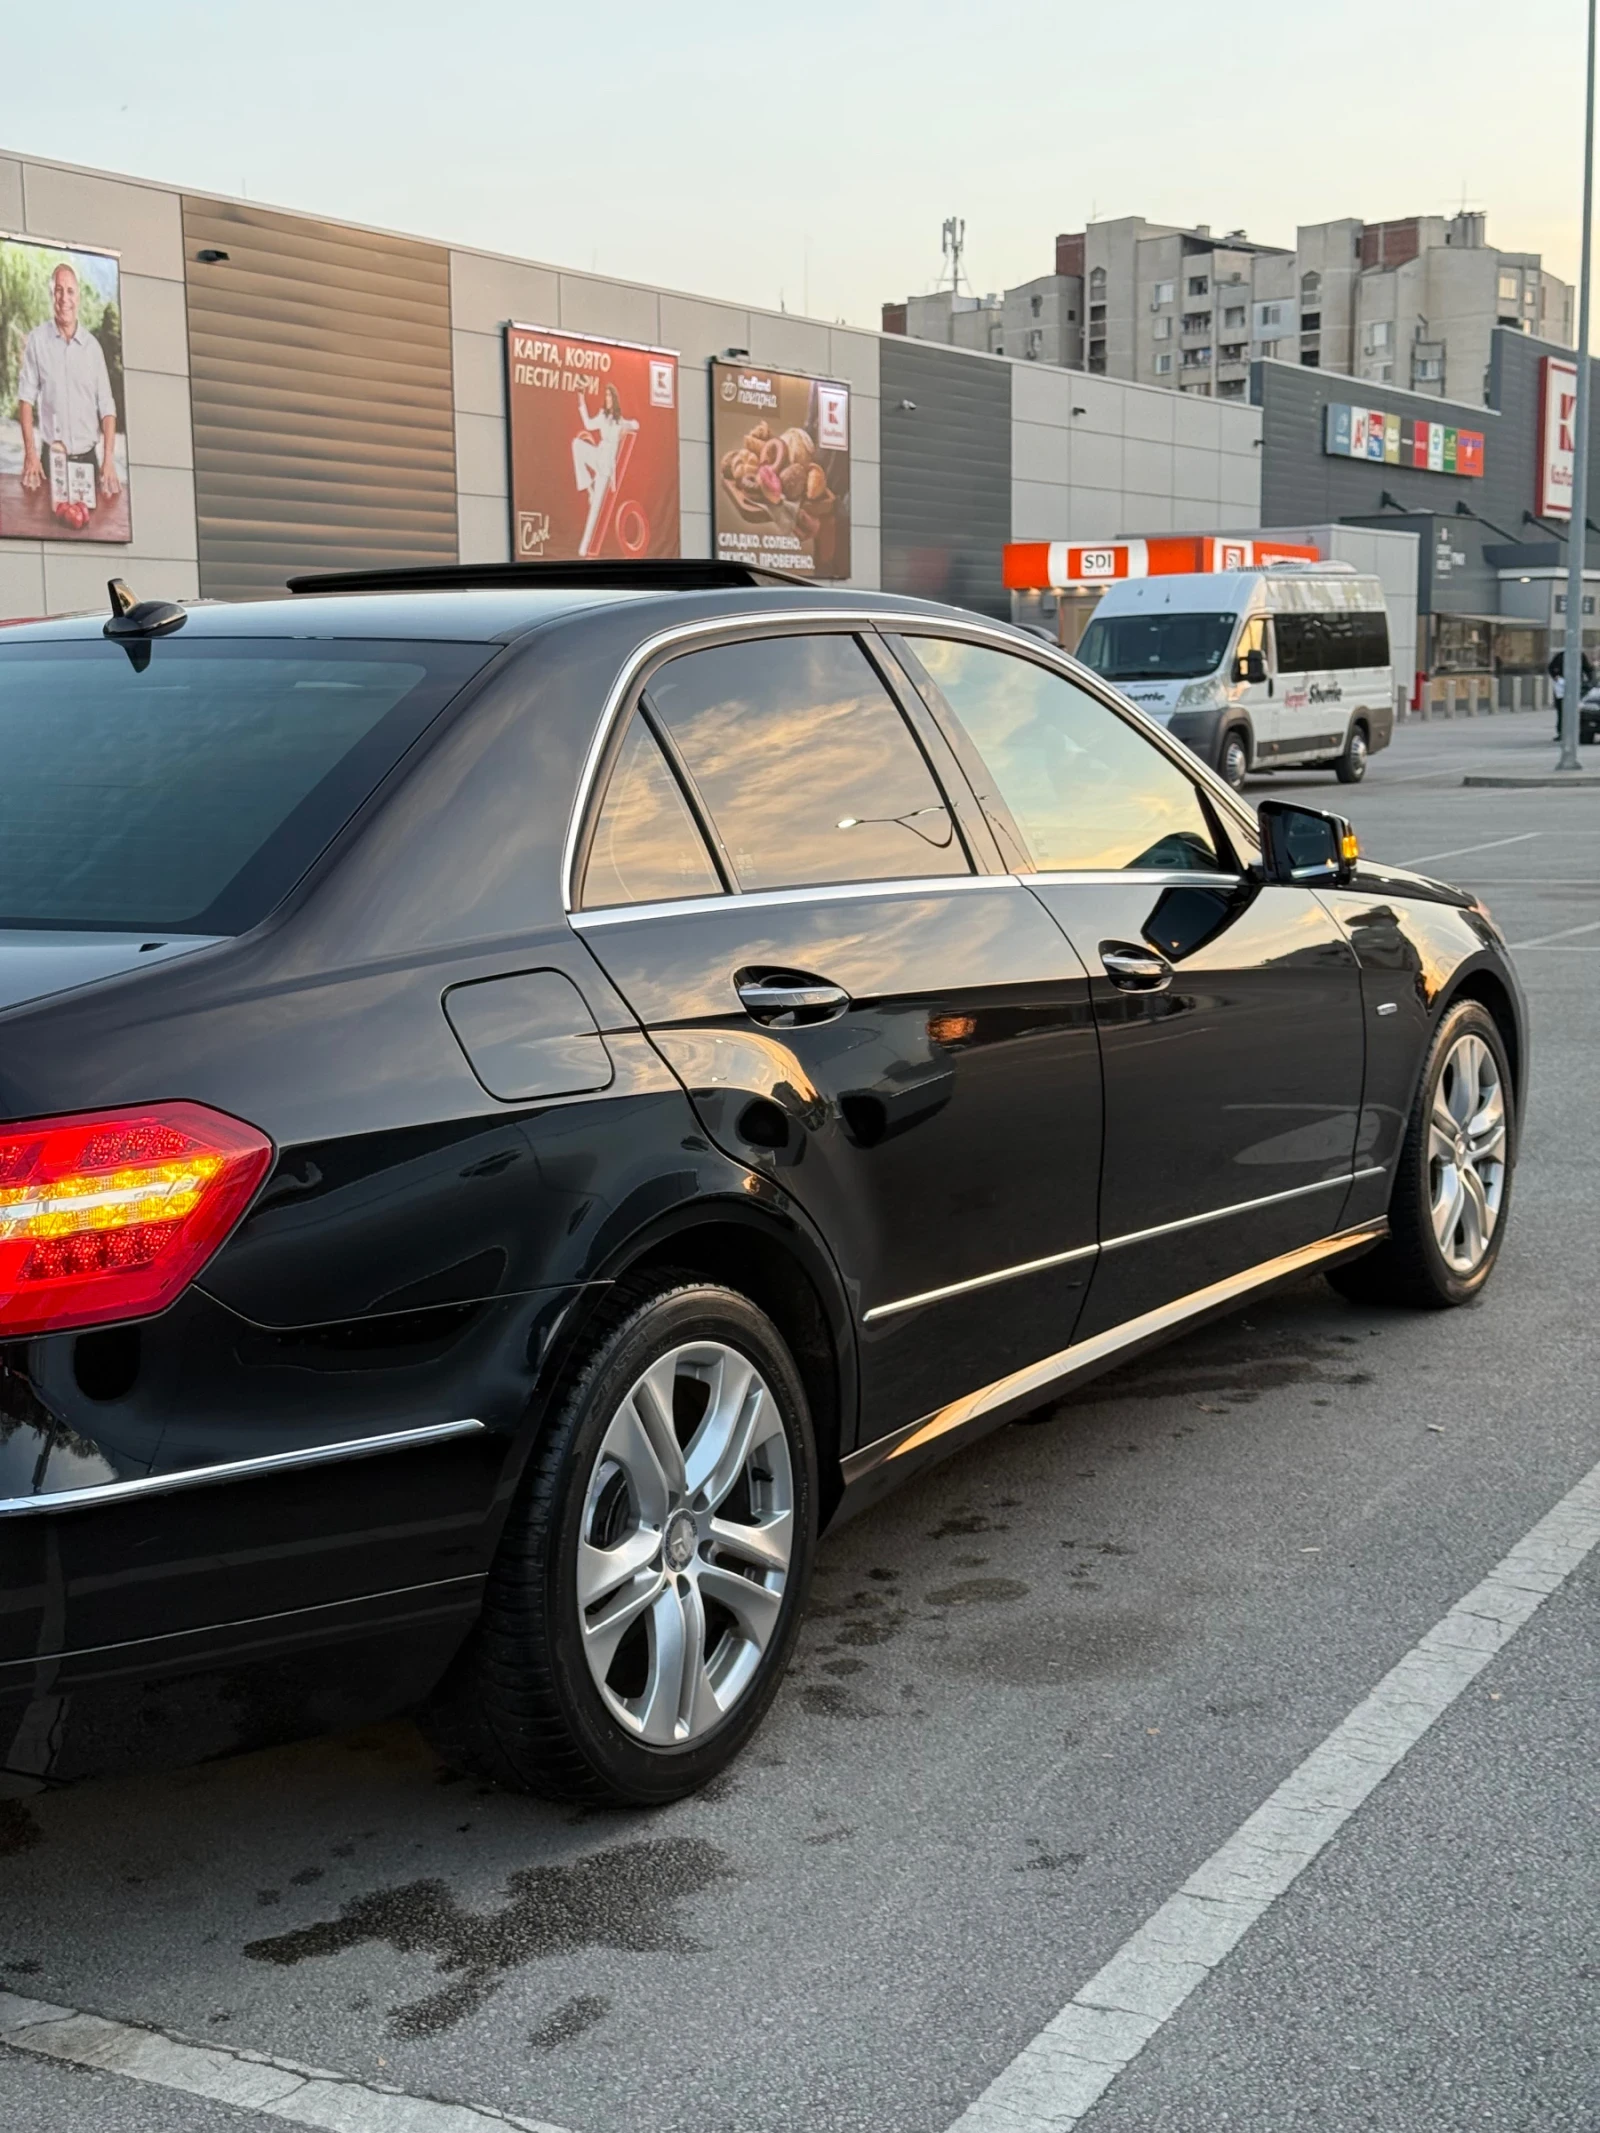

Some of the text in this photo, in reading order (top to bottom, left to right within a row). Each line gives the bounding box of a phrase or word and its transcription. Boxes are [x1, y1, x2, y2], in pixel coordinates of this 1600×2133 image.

[514, 337, 612, 373] КАРТА, КОЯТО
[514, 364, 560, 391] ПЕСТИ
[522, 514, 550, 550] Card
[718, 532, 802, 551] СЛАДКО. СОЛЕНО.
[1084, 553, 1112, 569] SDI
